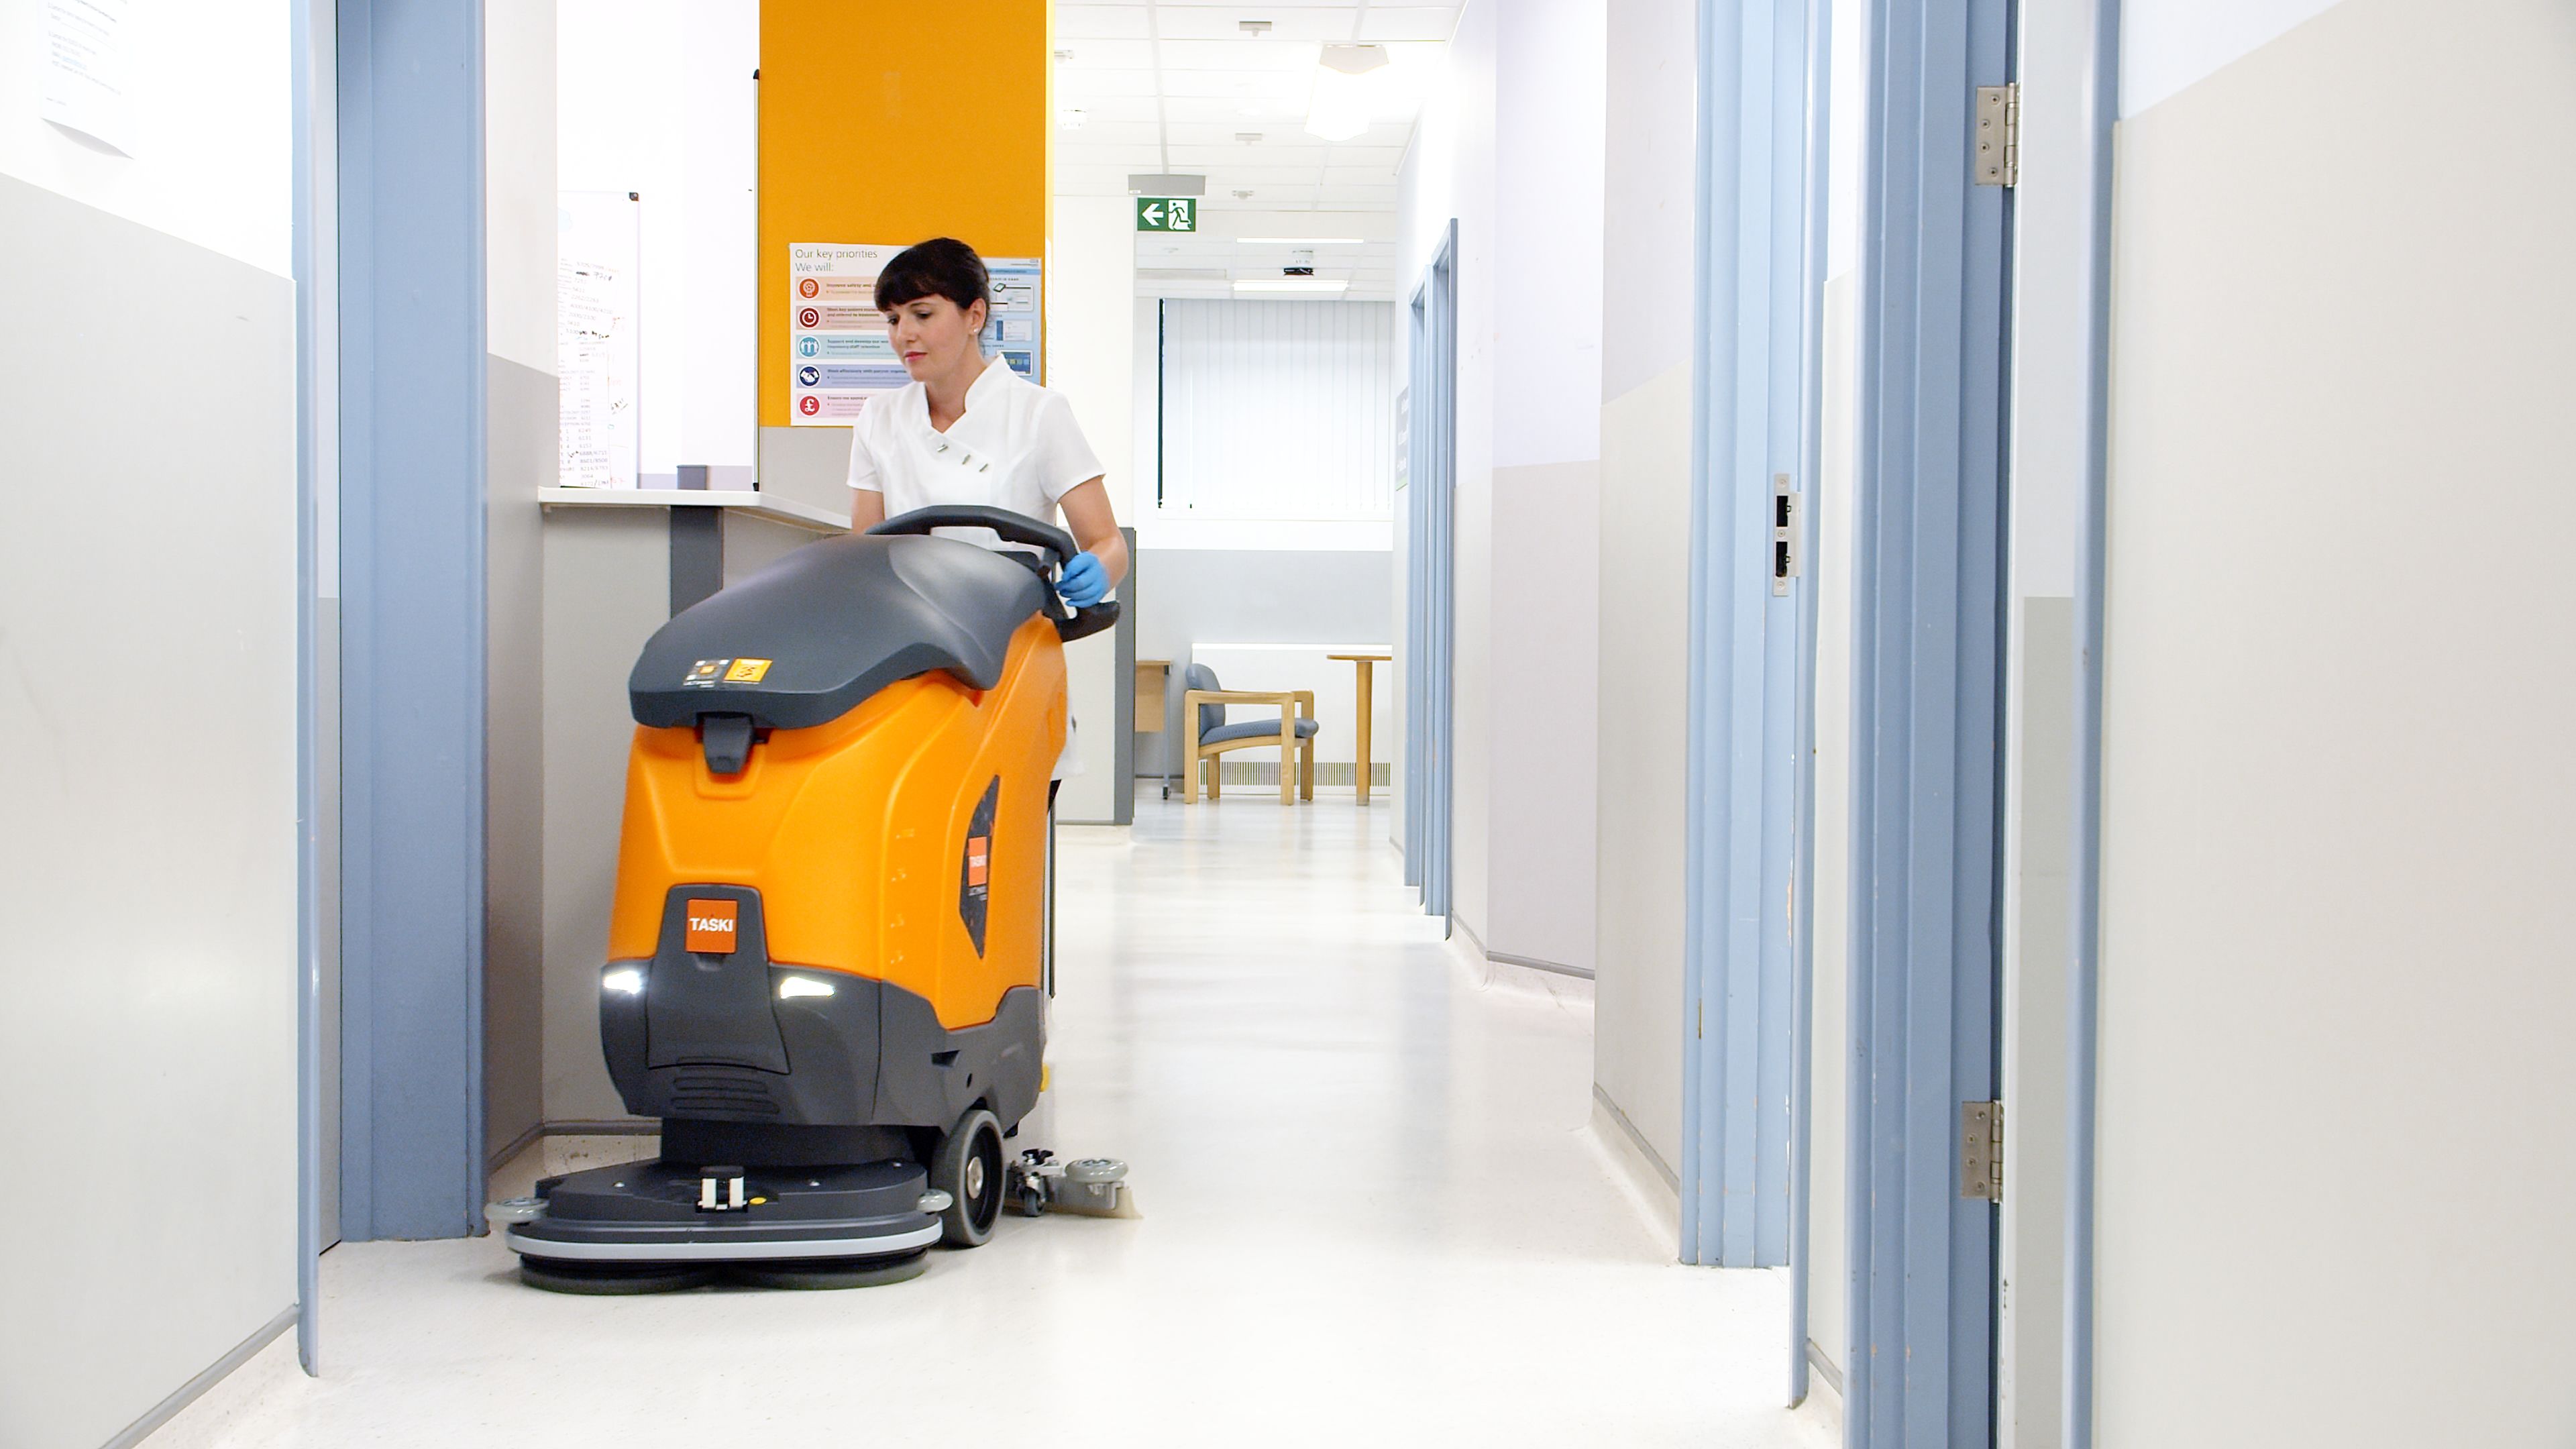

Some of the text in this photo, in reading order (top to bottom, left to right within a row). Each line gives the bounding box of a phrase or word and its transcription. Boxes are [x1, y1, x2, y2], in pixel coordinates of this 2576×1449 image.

[795, 249, 878, 260] Our key priorities
[795, 262, 834, 272] We will:
[690, 918, 734, 932] TASKI
